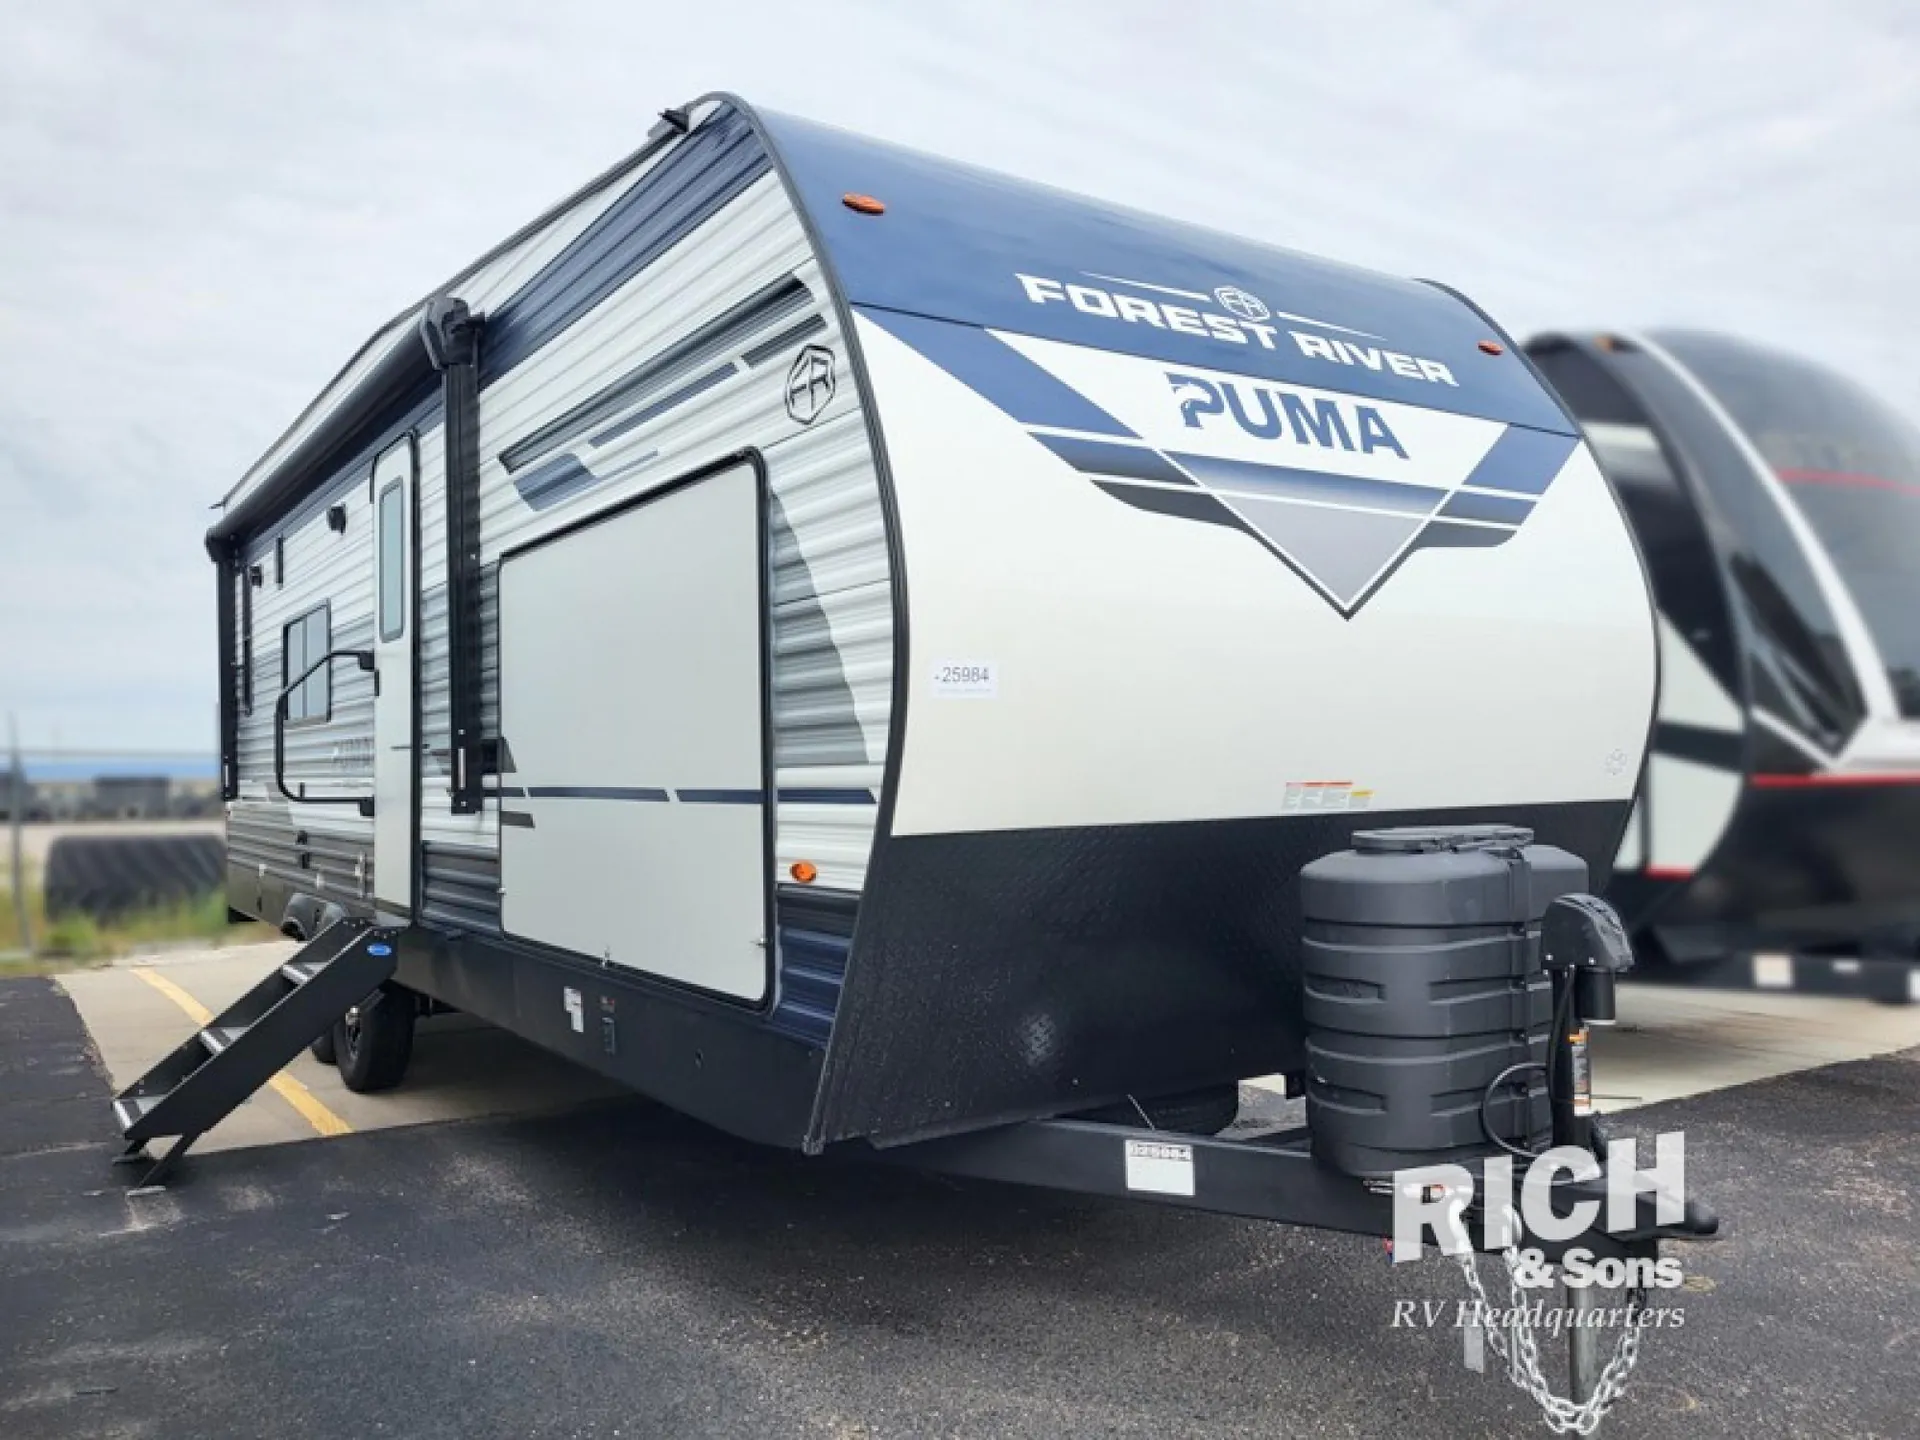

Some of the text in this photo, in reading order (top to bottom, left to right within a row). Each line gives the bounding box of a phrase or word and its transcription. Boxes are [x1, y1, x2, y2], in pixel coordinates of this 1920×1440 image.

[1014, 273, 1459, 387] FOREST RIVER
[1165, 371, 1409, 460] PUMA
